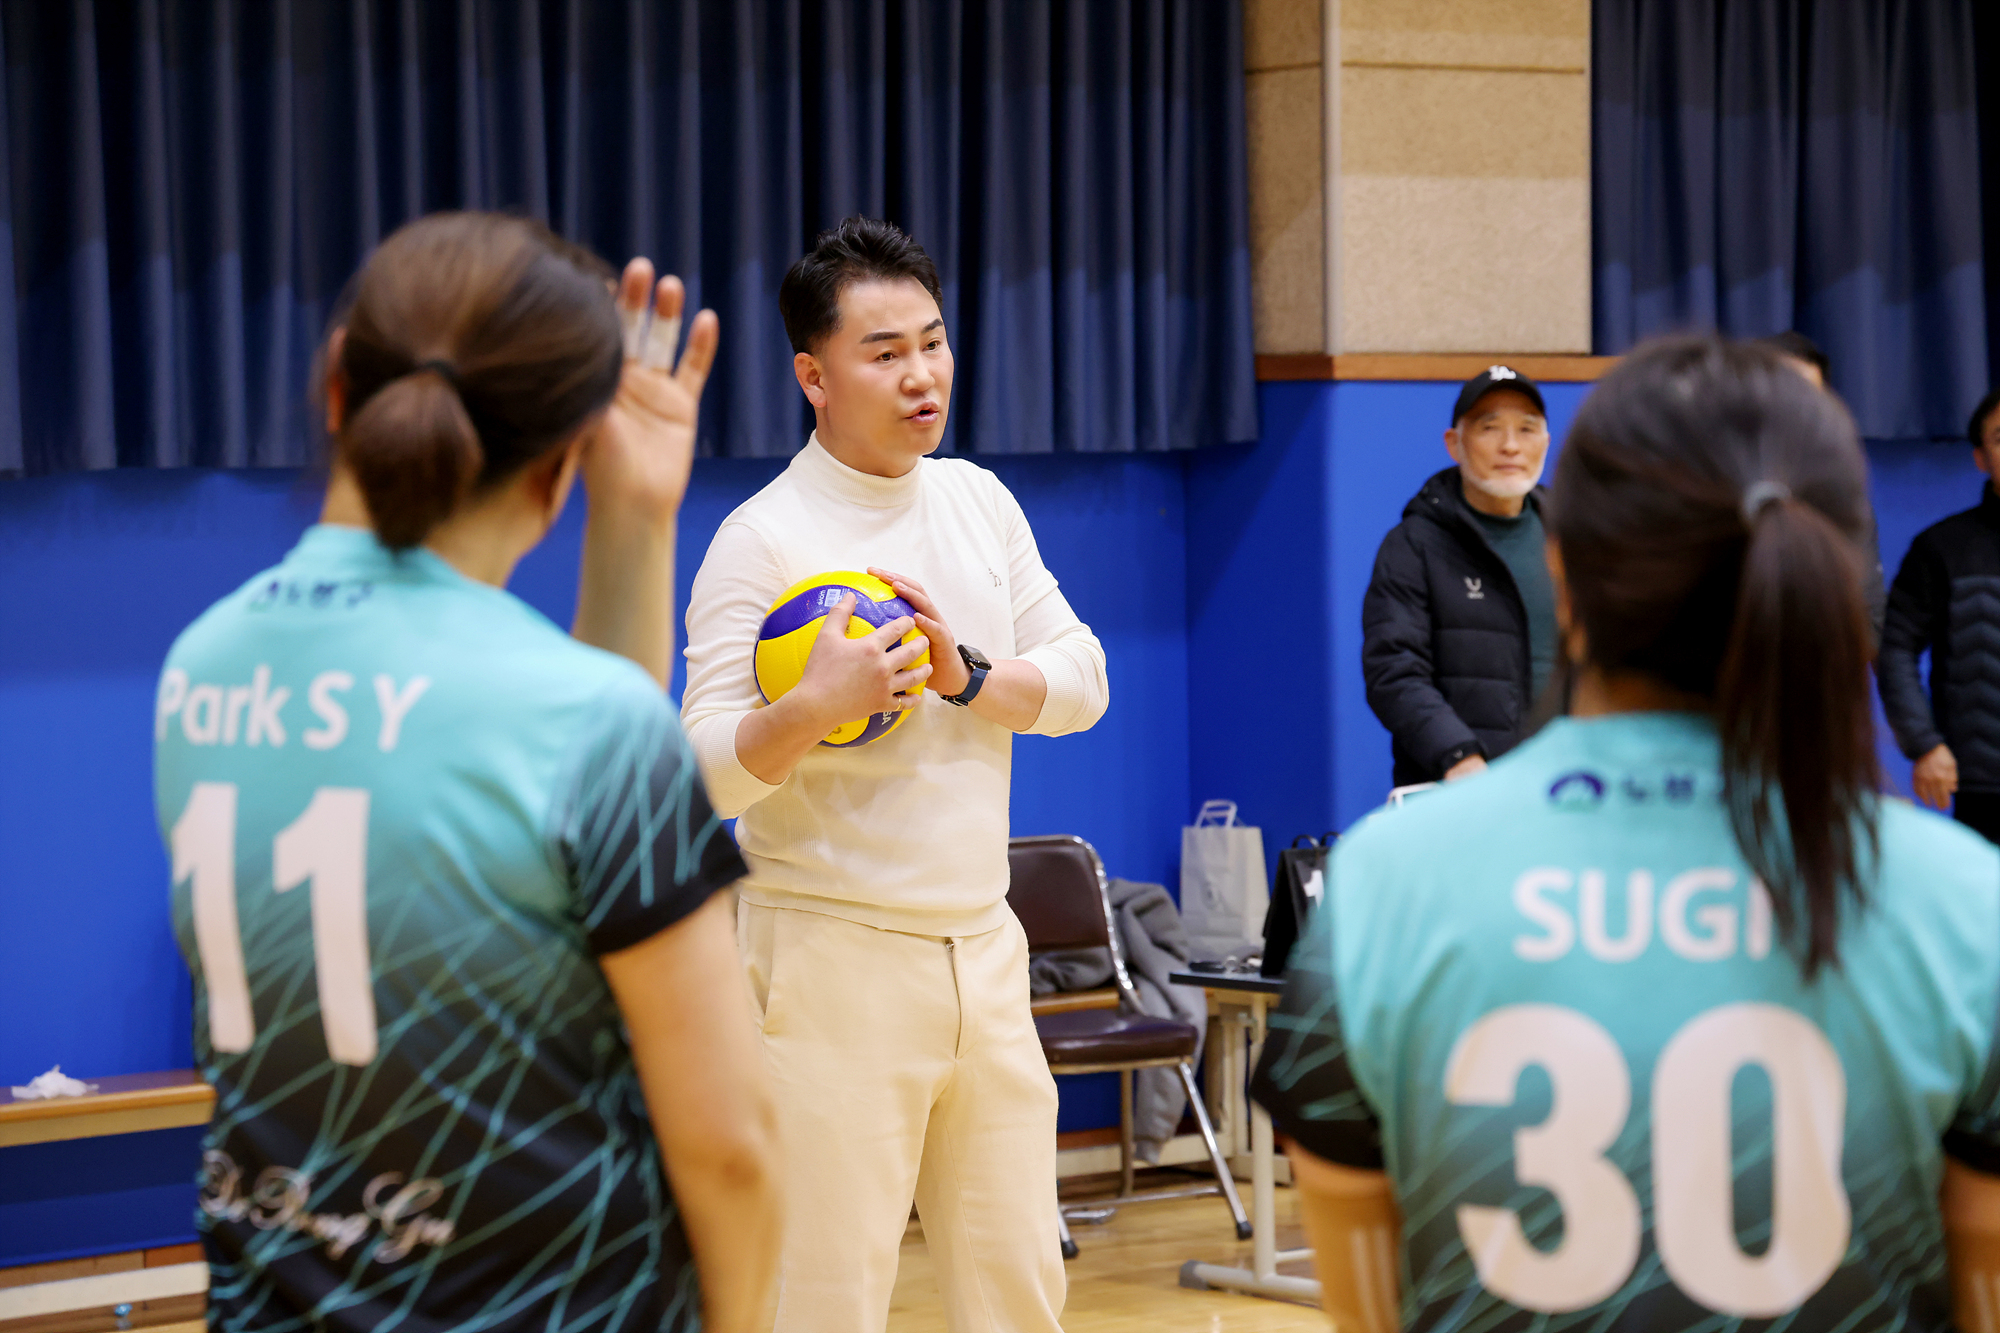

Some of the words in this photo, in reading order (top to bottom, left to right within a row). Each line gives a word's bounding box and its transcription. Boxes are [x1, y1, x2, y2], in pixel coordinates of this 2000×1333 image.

[155, 663, 292, 747] Park
[302, 669, 355, 751] S
[372, 673, 431, 753] Y
[171, 781, 379, 1067] 11
[1445, 1003, 1852, 1318] 30
